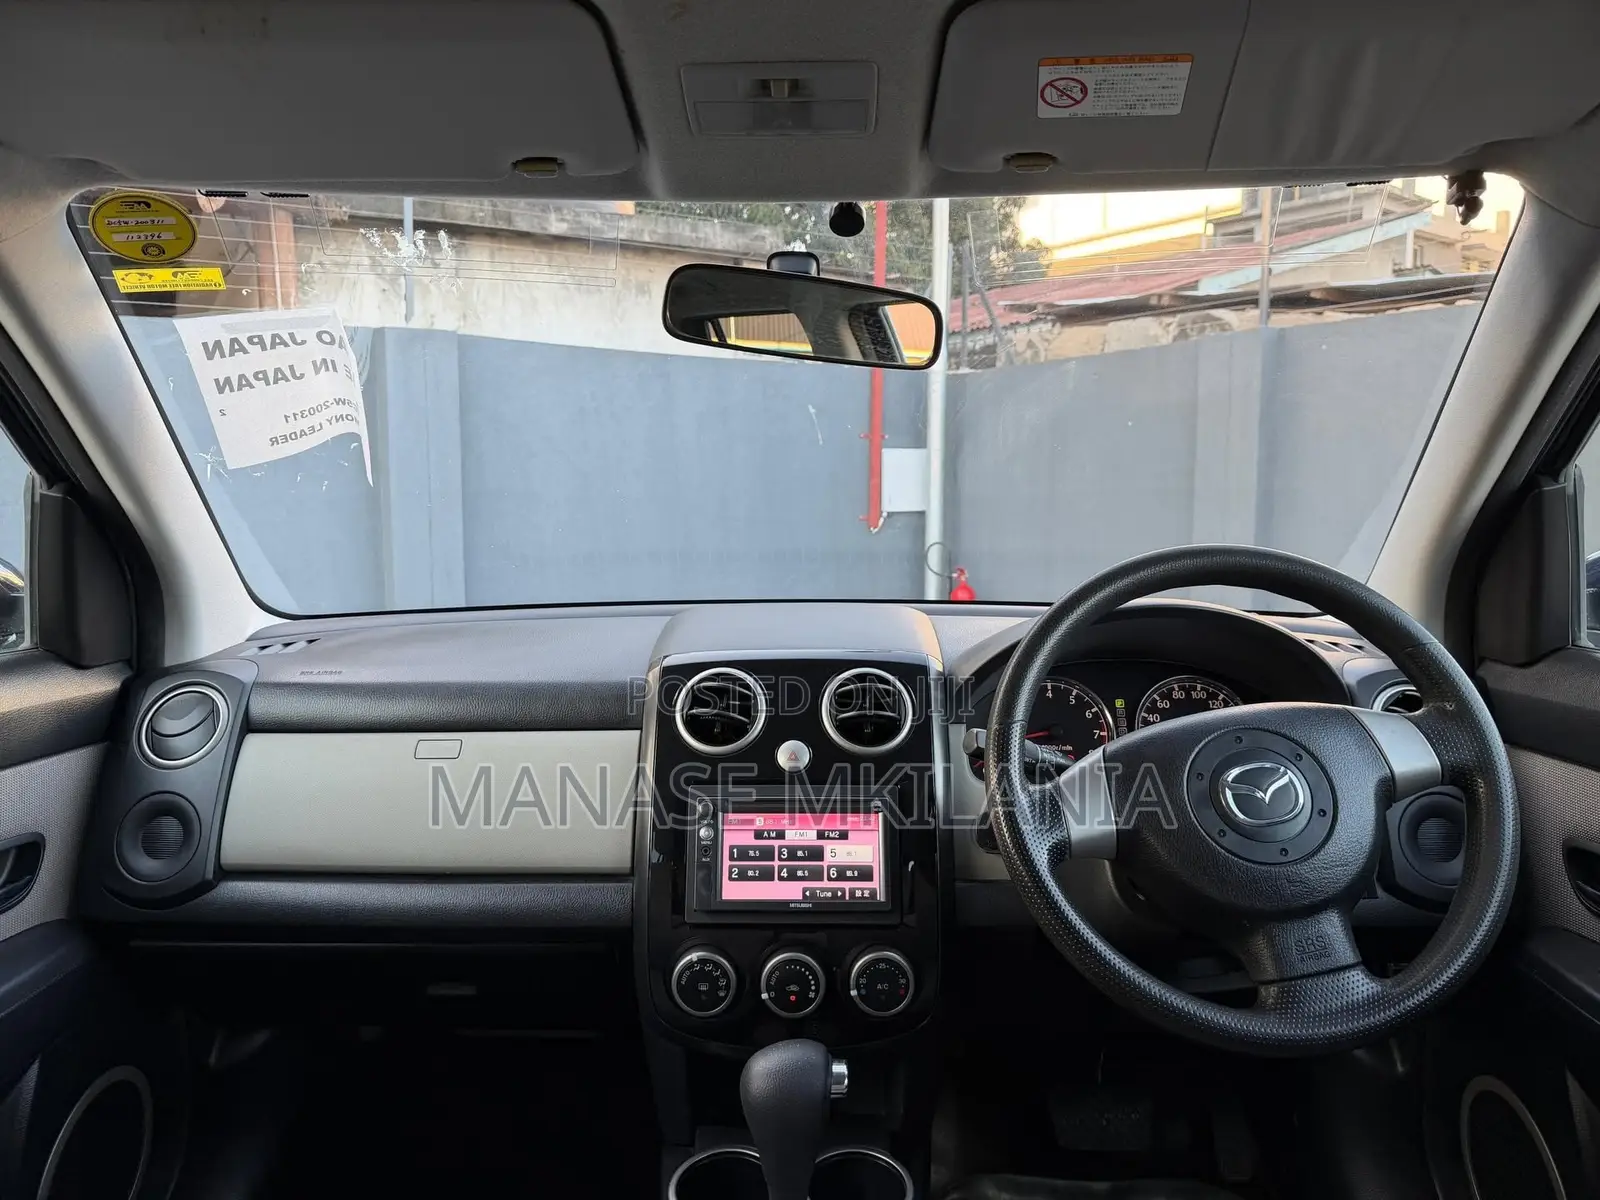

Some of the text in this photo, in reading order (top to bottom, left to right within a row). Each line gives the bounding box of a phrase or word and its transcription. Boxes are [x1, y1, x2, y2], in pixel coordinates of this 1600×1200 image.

[1046, 690, 1053, 699] 4
[1172, 690, 1185, 699] 80
[1191, 690, 1207, 699] 100
[1069, 696, 1076, 705] 5
[1157, 699, 1170, 709] 60
[1208, 700, 1224, 709] 120
[1085, 709, 1093, 719] 6
[1147, 713, 1160, 723] 40
[1093, 730, 1100, 739] 7
[732, 848, 738, 859] 1
[780, 848, 788, 859] 3
[830, 848, 837, 858] 5
[731, 868, 738, 879] 2
[780, 868, 788, 878] 4
[830, 868, 837, 879] 6
[816, 890, 832, 898] Tune
